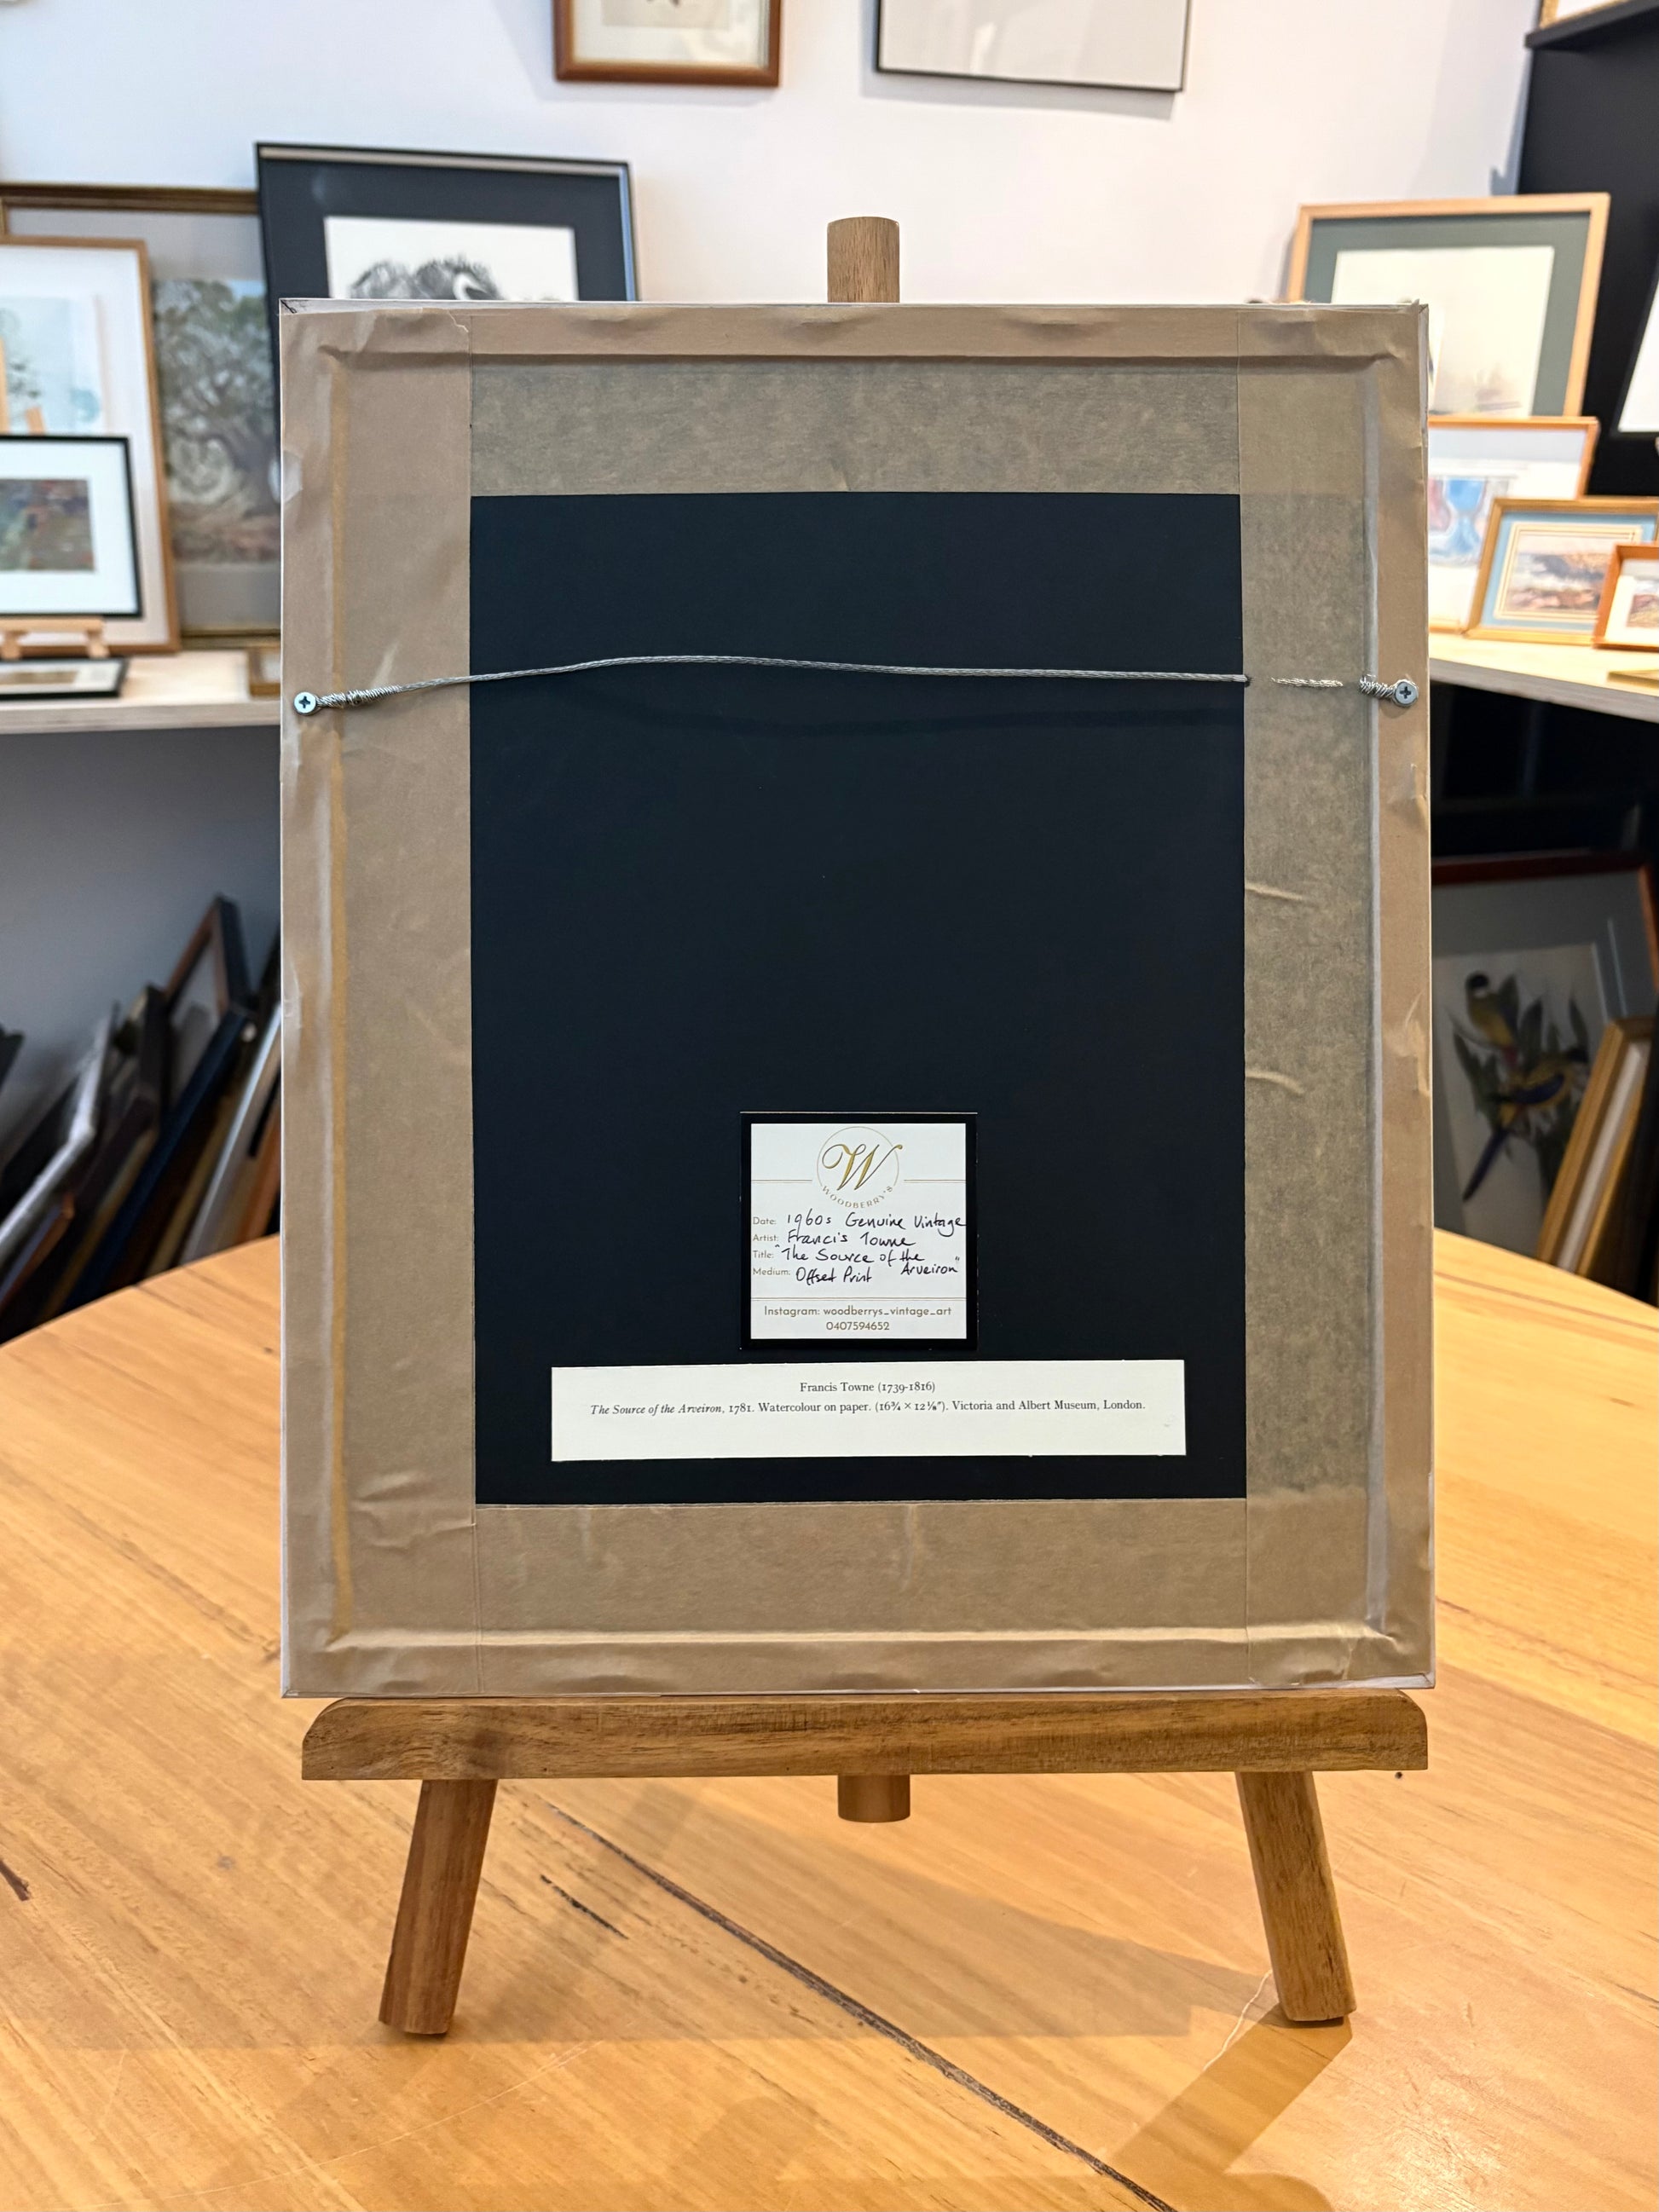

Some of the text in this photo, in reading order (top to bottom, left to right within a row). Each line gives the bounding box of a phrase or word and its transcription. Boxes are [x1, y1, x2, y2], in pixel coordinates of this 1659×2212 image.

[752, 1208, 967, 1240] Date: 1960s Genuine Vintage
[752, 1228, 916, 1247] Artist: Francis Towne
[752, 1250, 774, 1259] Title:
[815, 1248, 875, 1262] Source
[879, 1249, 898, 1267] of
[899, 1248, 926, 1262] the
[752, 1265, 872, 1285] Medium: Offset Print
[764, 1305, 951, 1317] Instagram: woodberrys_vintage_art
[826, 1321, 890, 1331] 0407594652
[800, 1381, 935, 1394] Francis Towne (1739-1816)
[591, 1405, 610, 1414] The
[612, 1404, 645, 1414] Source
[648, 1404, 660, 1416] of
[660, 1404, 675, 1414] the
[679, 1403, 725, 1415] Arveiron,
[729, 1403, 755, 1415] 1781.
[758, 1402, 821, 1412] Watercolour
[840, 1404, 871, 1415] paper.
[952, 1401, 993, 1411] Victoria
[996, 1401, 1015, 1411] and
[1018, 1401, 1050, 1411] Albert
[1054, 1401, 1100, 1412] Museum,
[1103, 1401, 1146, 1411] London.
